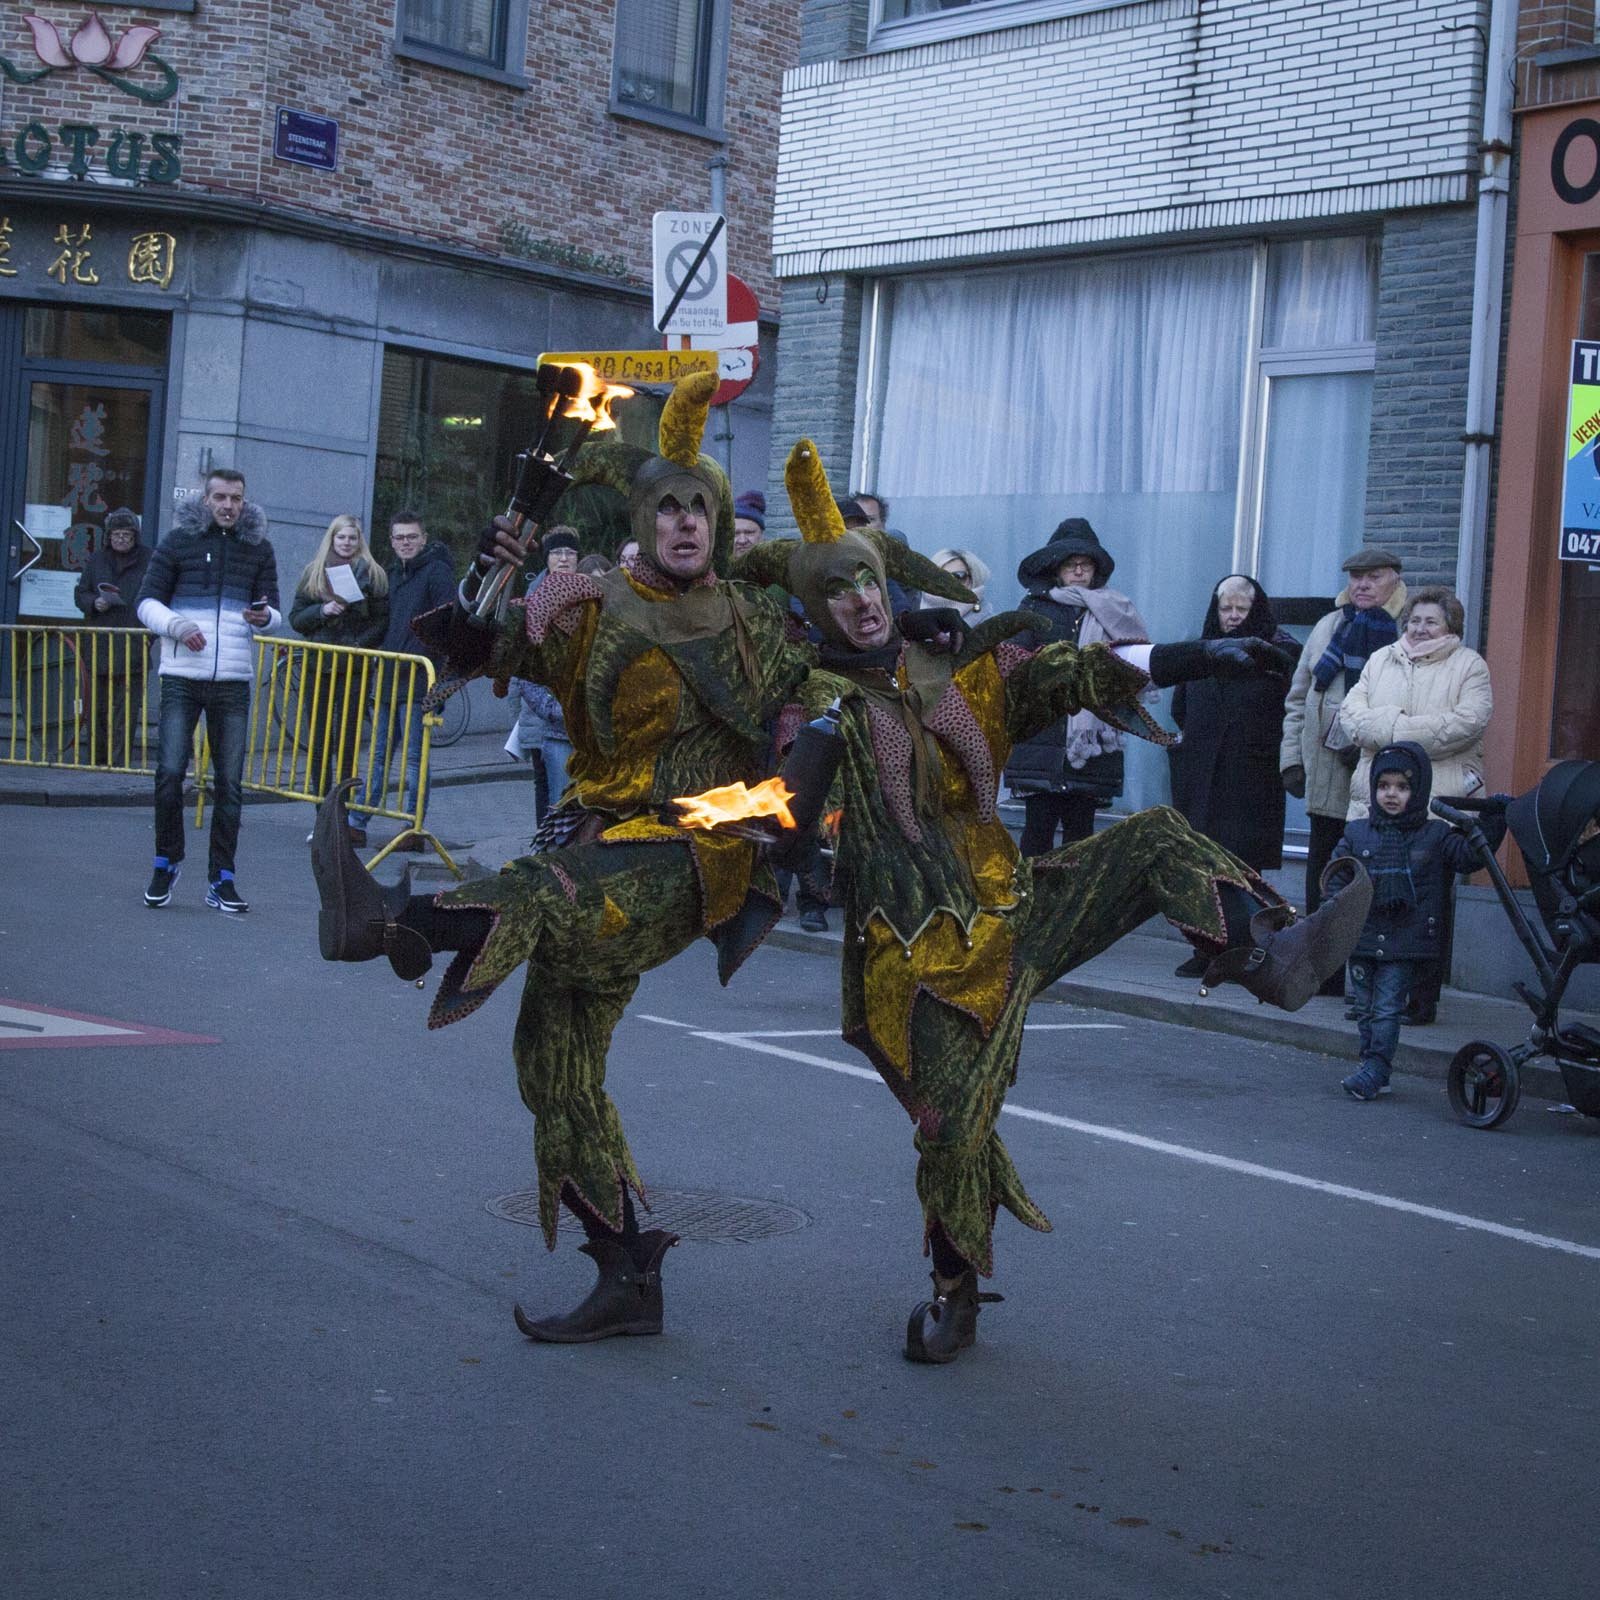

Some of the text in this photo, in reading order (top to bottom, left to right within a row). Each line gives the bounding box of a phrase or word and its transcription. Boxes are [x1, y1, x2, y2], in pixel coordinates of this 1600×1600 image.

[0, 123, 182, 183] OTUS
[670, 220, 712, 235] ZONE
[679, 305, 720, 316] maandag
[622, 356, 664, 377] Casa
[1580, 348, 1600, 381] T
[1573, 409, 1600, 445] VERK
